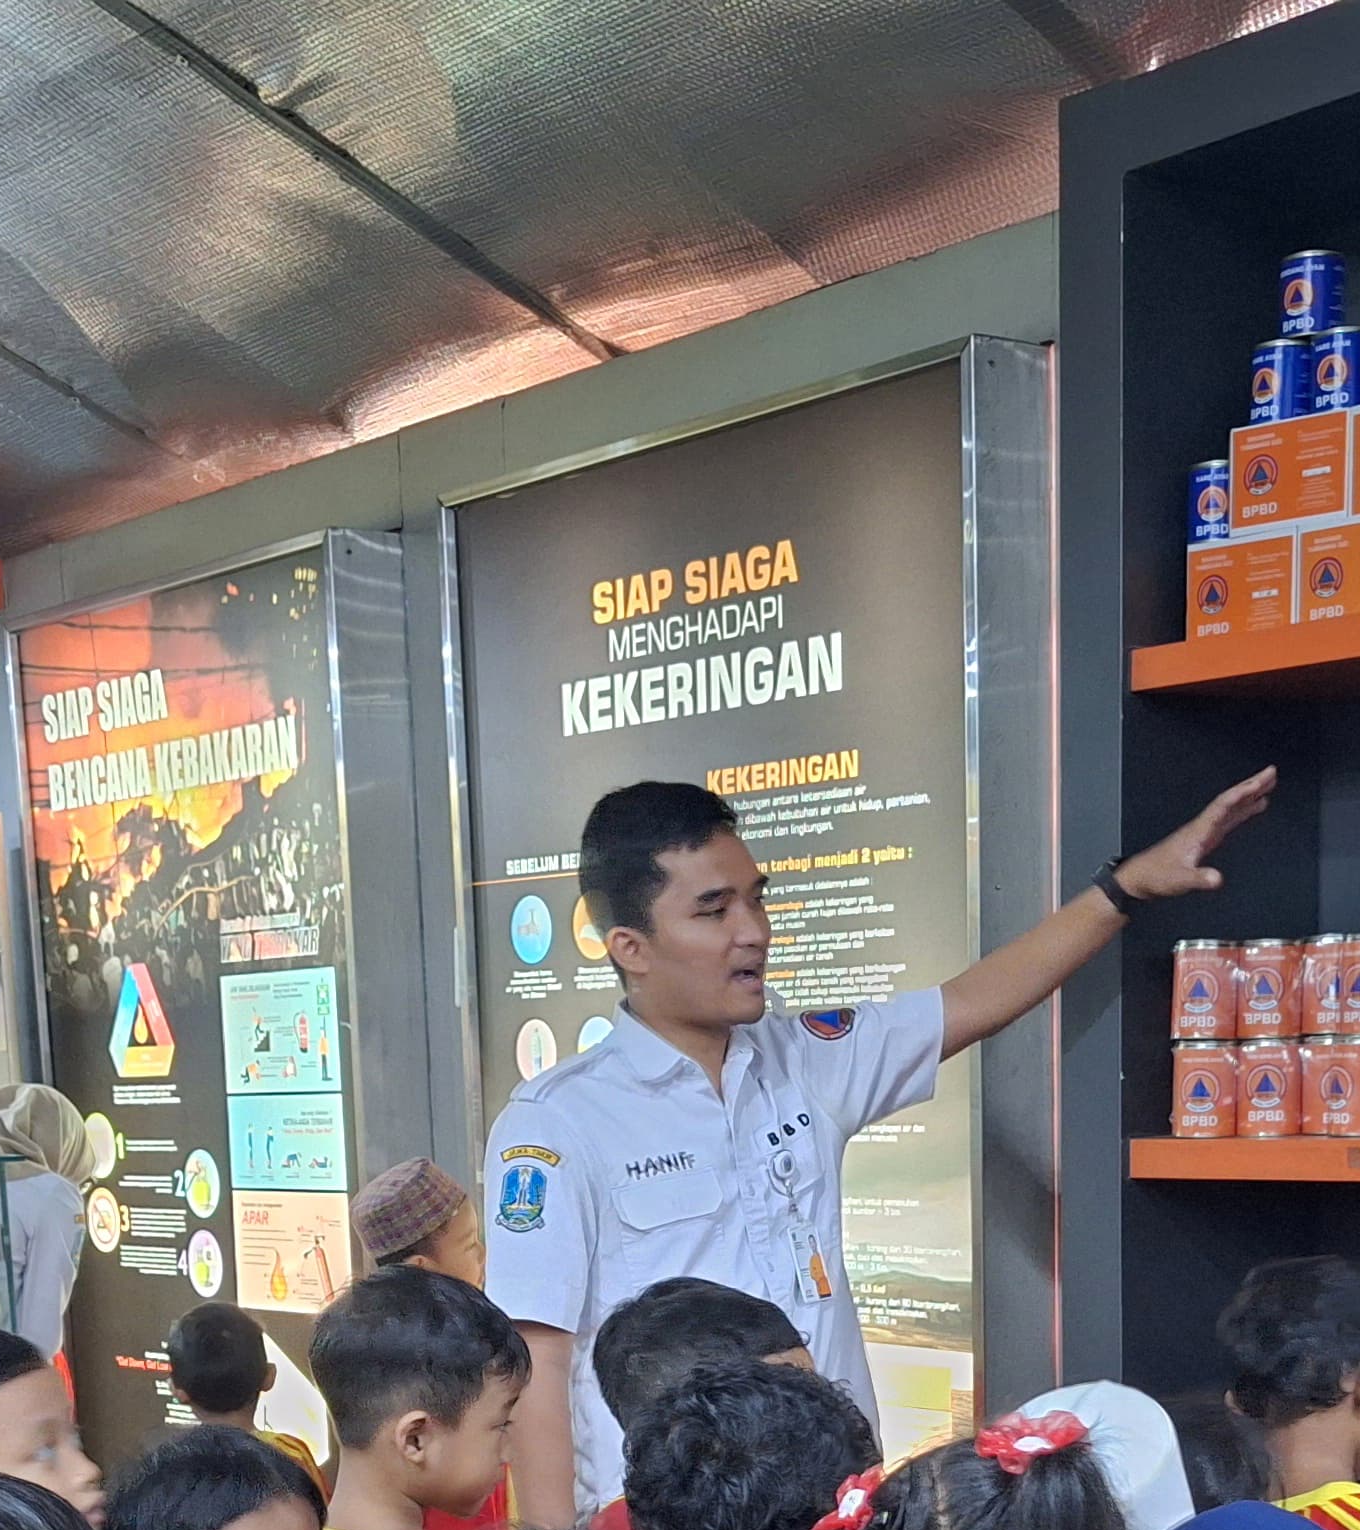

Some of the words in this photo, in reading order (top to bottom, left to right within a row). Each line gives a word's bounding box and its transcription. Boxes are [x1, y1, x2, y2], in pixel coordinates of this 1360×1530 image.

[1282, 317, 1315, 334] BPBD
[1315, 392, 1350, 408] BPBD
[1242, 502, 1278, 519] BPBD
[1195, 523, 1229, 537] BPBD
[593, 568, 673, 625] SIAP
[686, 539, 799, 605] SIAGA
[1309, 605, 1345, 621] BPBD
[608, 596, 784, 662] MENGHADAPI
[1197, 622, 1230, 637] BPBD
[561, 632, 843, 737] KEKERINGAN
[42, 686, 94, 743] SIAP
[97, 669, 168, 732] SIAGA
[48, 748, 152, 812] BENCANA
[153, 715, 299, 794] KEBAKARAN
[707, 749, 859, 795] KEKERINGAN
[733, 798, 771, 811] hubungan
[744, 812, 777, 825] dibawah
[741, 826, 773, 840] ekonomi
[774, 825, 789, 837] dan
[771, 854, 811, 873] terbagi
[814, 848, 859, 868] menjadi
[861, 847, 871, 863] 2
[873, 845, 905, 866] yaitu
[1180, 1016, 1217, 1028] BPBD
[1244, 1013, 1282, 1025] BPBD
[1182, 1115, 1217, 1127] BPBD
[1248, 1110, 1285, 1122] BPBD
[116, 1132, 125, 1160] 1
[625, 1151, 696, 1180] HANIF
[174, 1169, 185, 1197] 2
[120, 1204, 130, 1232] 3
[241, 1210, 270, 1225] APAR
[178, 1249, 188, 1276] 4
